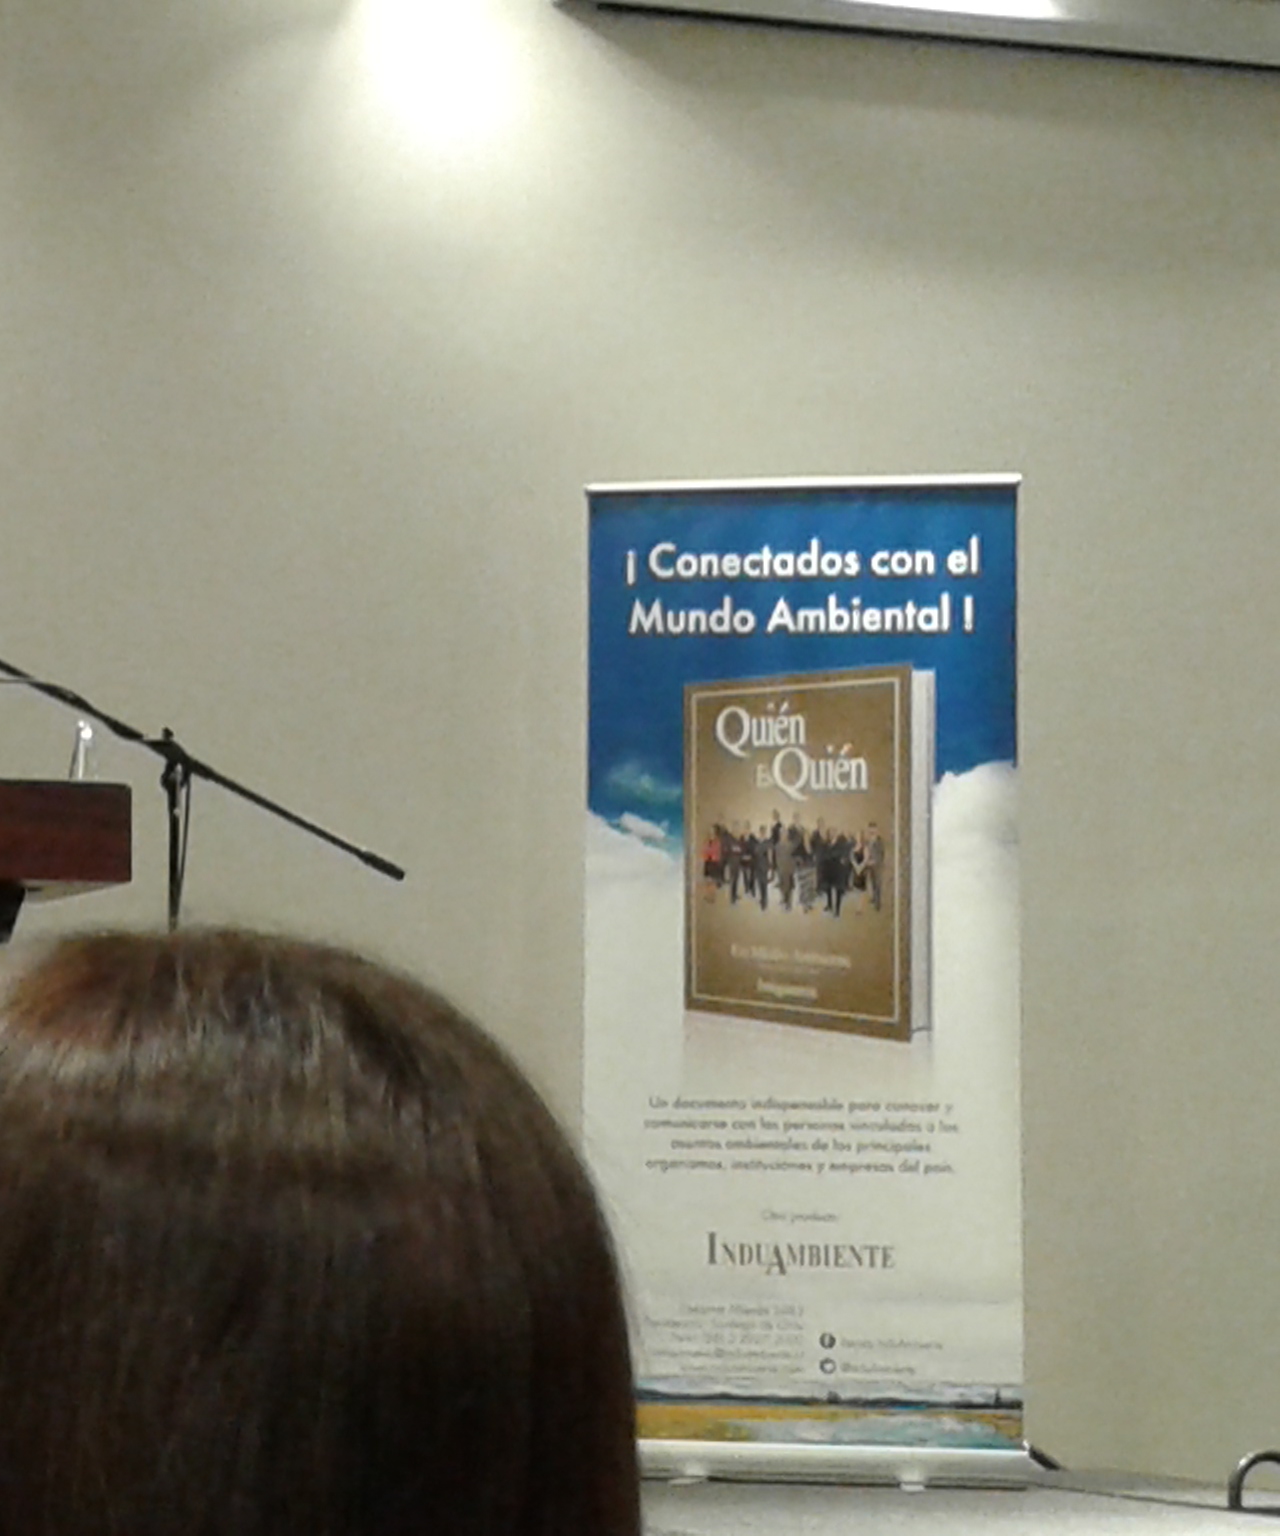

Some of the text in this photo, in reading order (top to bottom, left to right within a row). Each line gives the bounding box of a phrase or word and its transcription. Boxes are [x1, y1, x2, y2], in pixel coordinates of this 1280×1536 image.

[648, 535, 860, 578] Conectados
[870, 547, 936, 577] con
[946, 533, 980, 576] el
[628, 595, 756, 636] Mundo
[766, 591, 951, 634] Ambiental
[716, 702, 807, 757] Quién
[772, 743, 869, 800] Quién
[673, 1096, 747, 1110] documento
[848, 1101, 881, 1114] para
[731, 1120, 757, 1131] con
[783, 1120, 845, 1134] personas
[811, 1138, 829, 1151] de
[856, 1138, 932, 1156] principales
[816, 1163, 826, 1175] y
[829, 1162, 895, 1174] empresas
[898, 1159, 921, 1173] del
